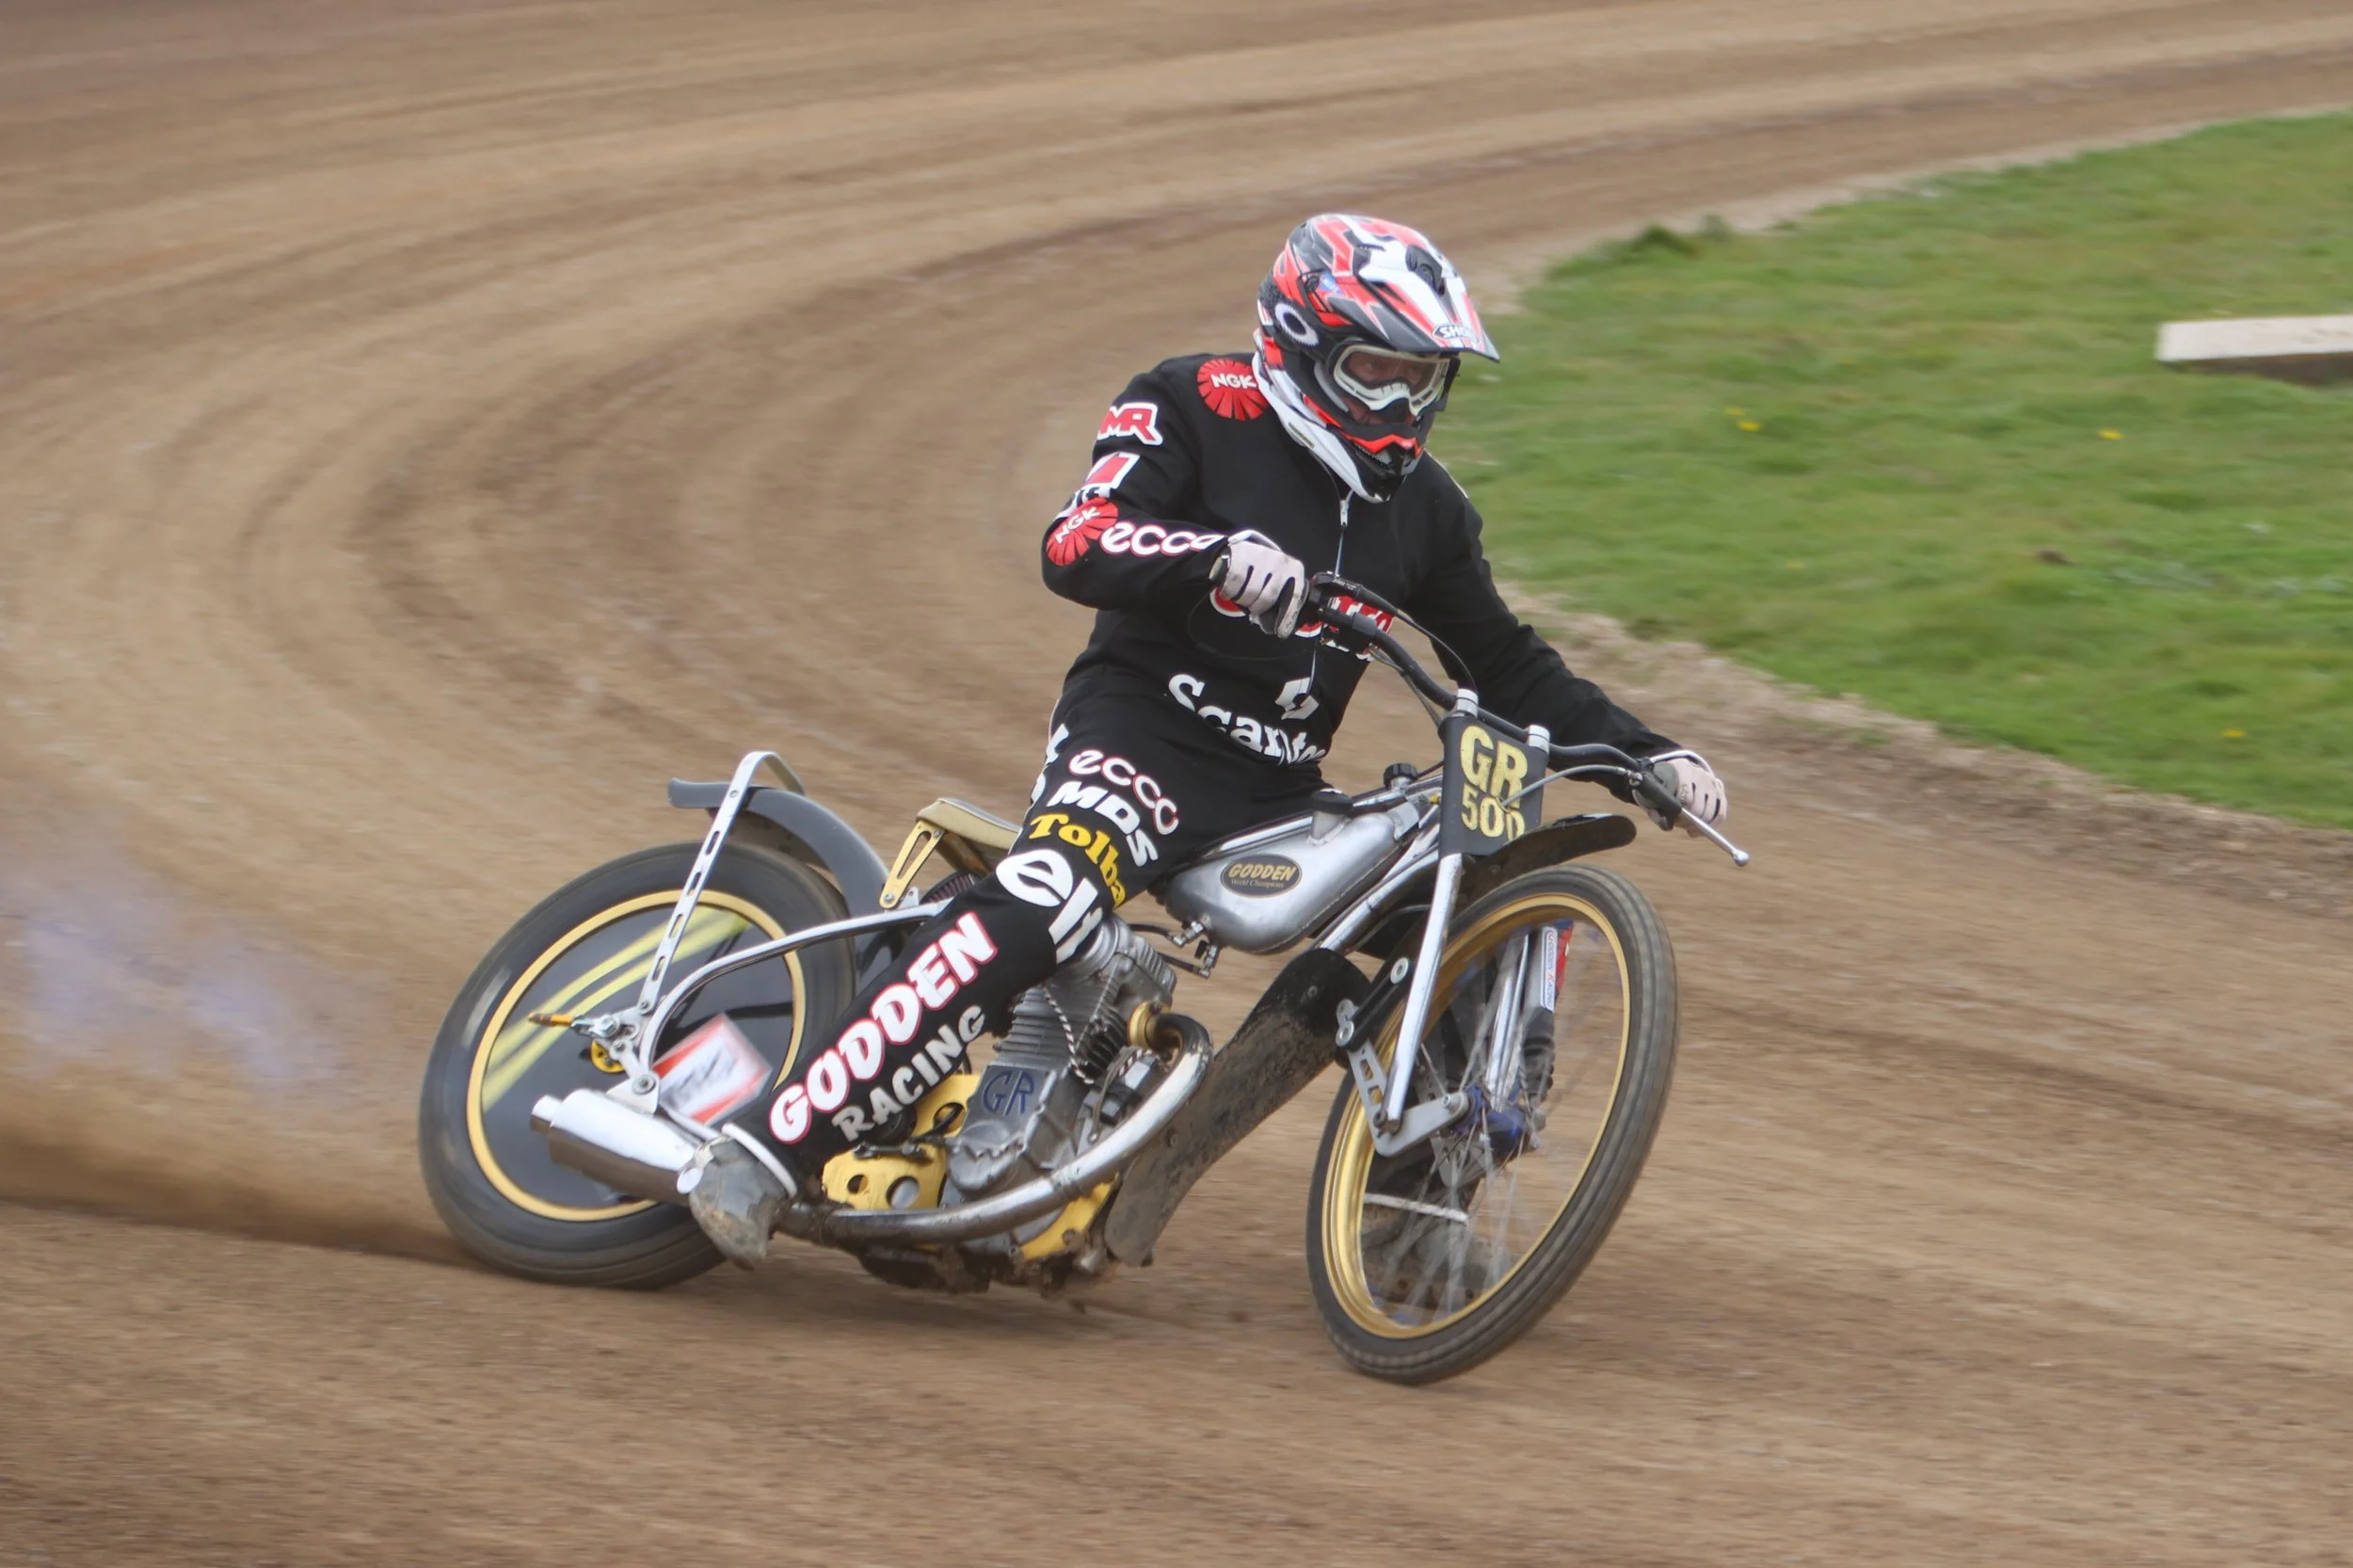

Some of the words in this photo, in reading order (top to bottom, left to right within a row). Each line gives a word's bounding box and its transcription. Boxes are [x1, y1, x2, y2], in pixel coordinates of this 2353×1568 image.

[1211, 373, 1257, 390] NGK
[1054, 506, 1101, 545] NGK
[1461, 725, 1529, 809] GR
[1046, 780, 1159, 867] MDS
[1227, 862, 1297, 882] GODDEN
[770, 912, 998, 1144] GODDEN
[831, 1005, 985, 1142] RACING
[983, 1069, 1035, 1117] GR
